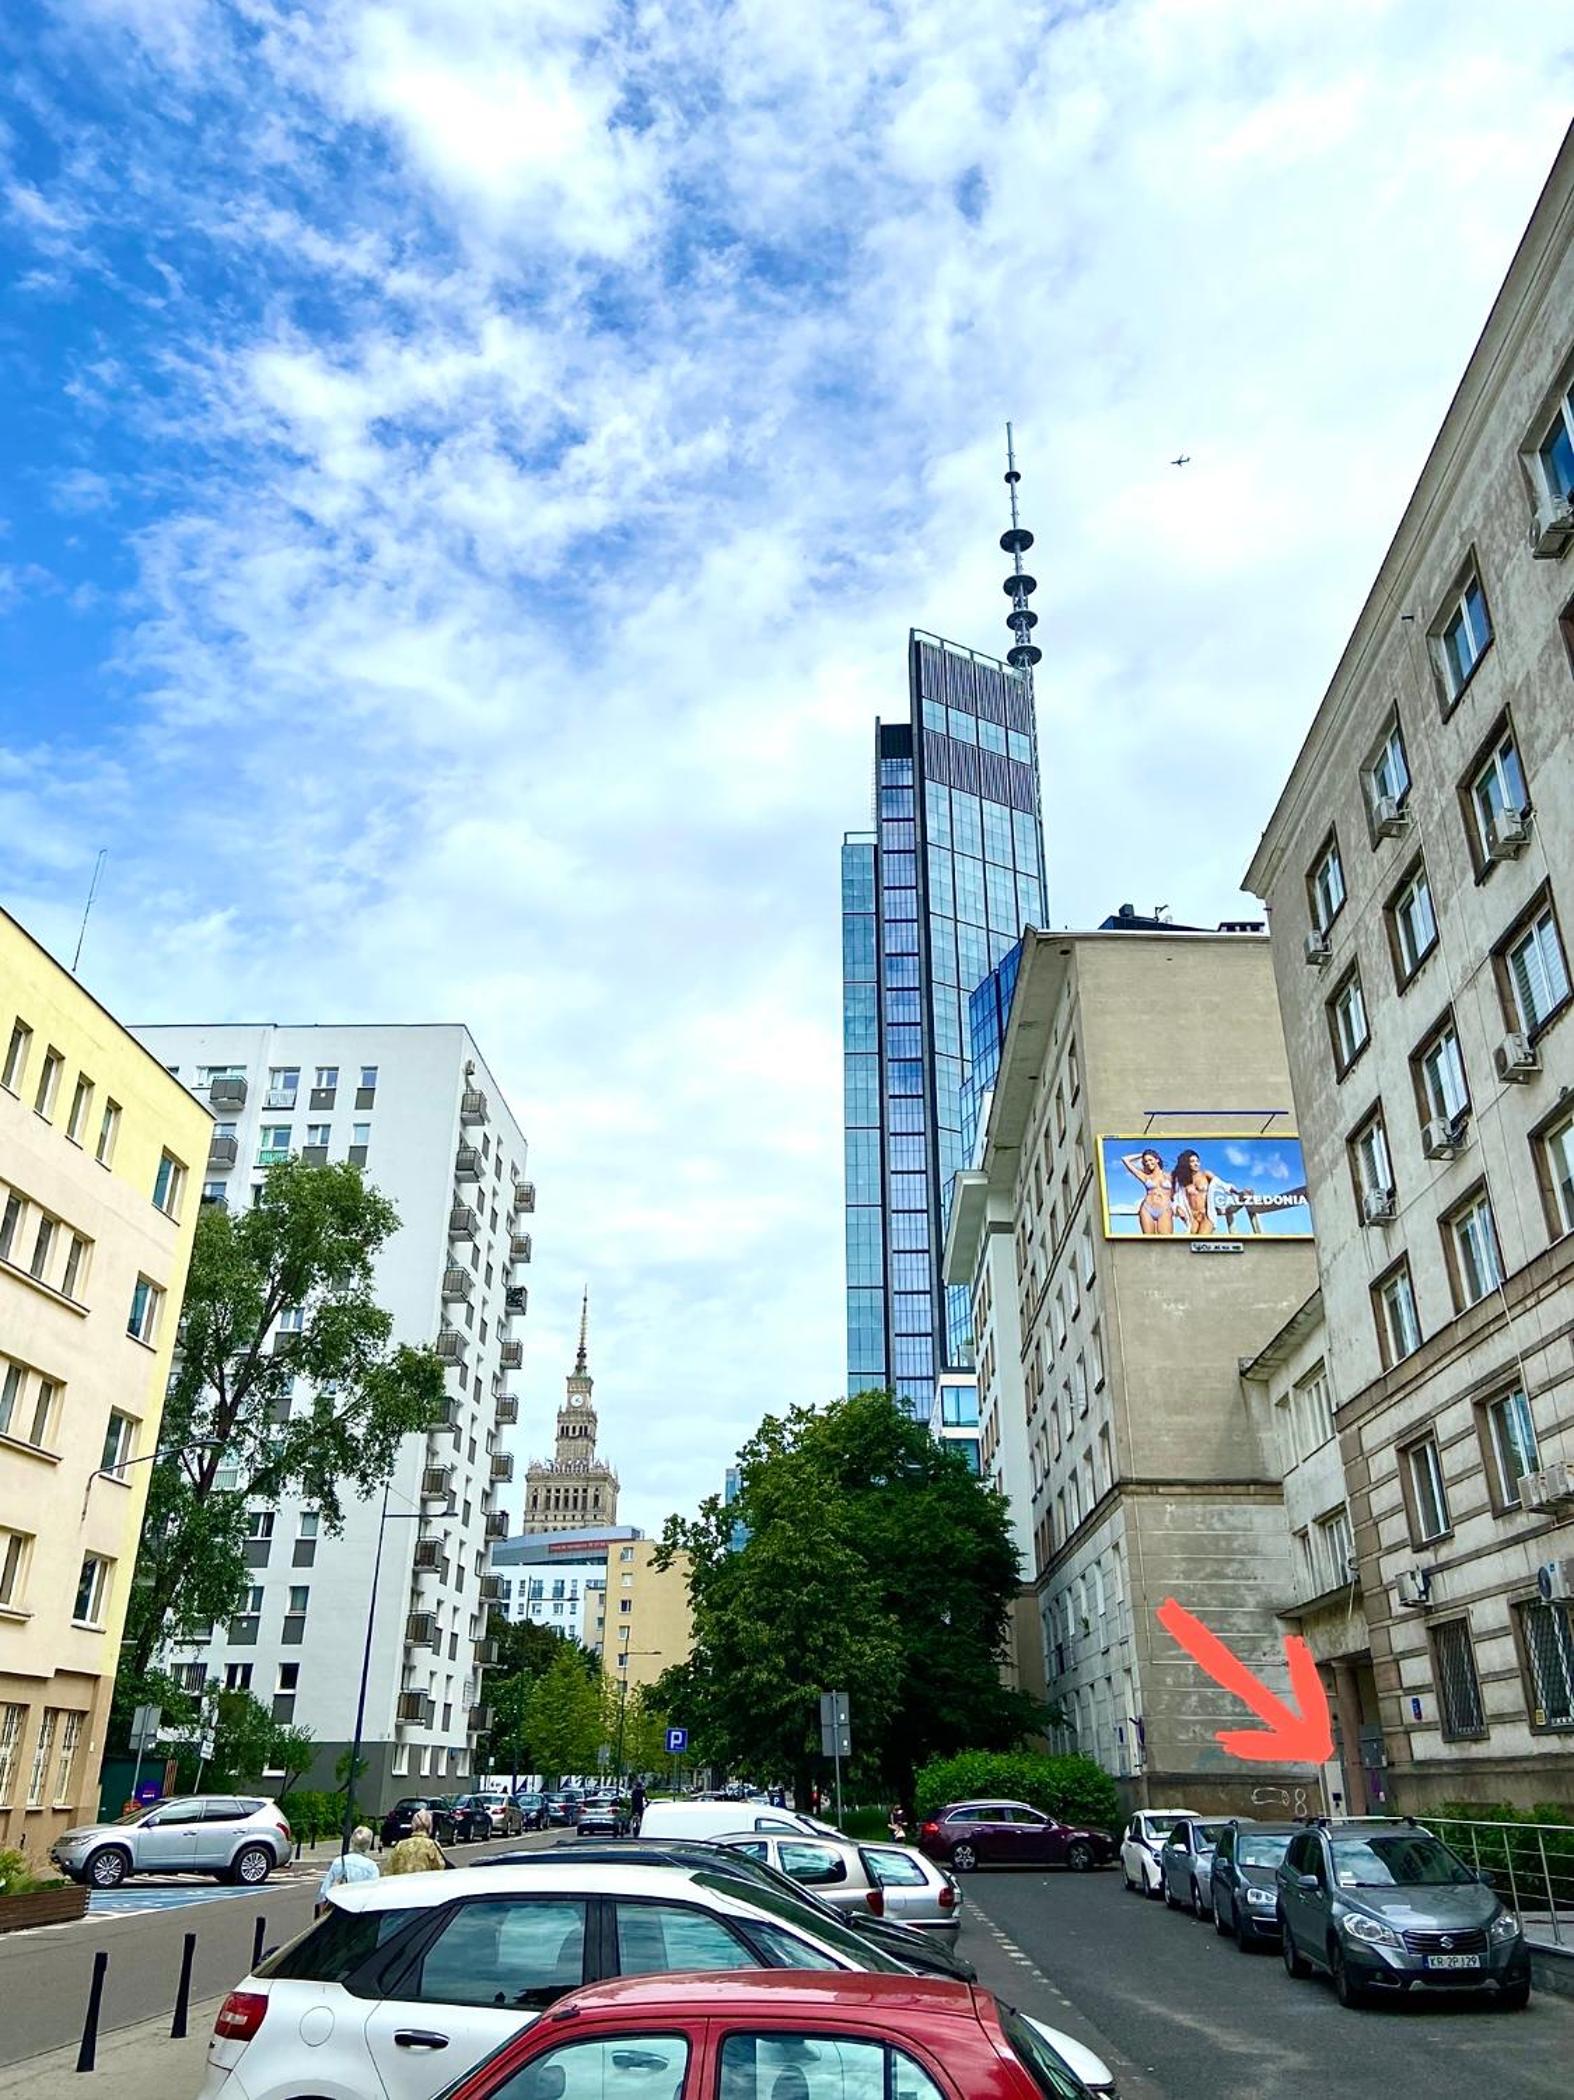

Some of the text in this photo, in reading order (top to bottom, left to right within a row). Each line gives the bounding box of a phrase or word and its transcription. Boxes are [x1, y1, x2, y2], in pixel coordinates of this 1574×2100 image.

[1214, 1194, 1307, 1205] CALZEDONIA
[670, 1731, 683, 1749] P
[1430, 1956, 1444, 1967] KR
